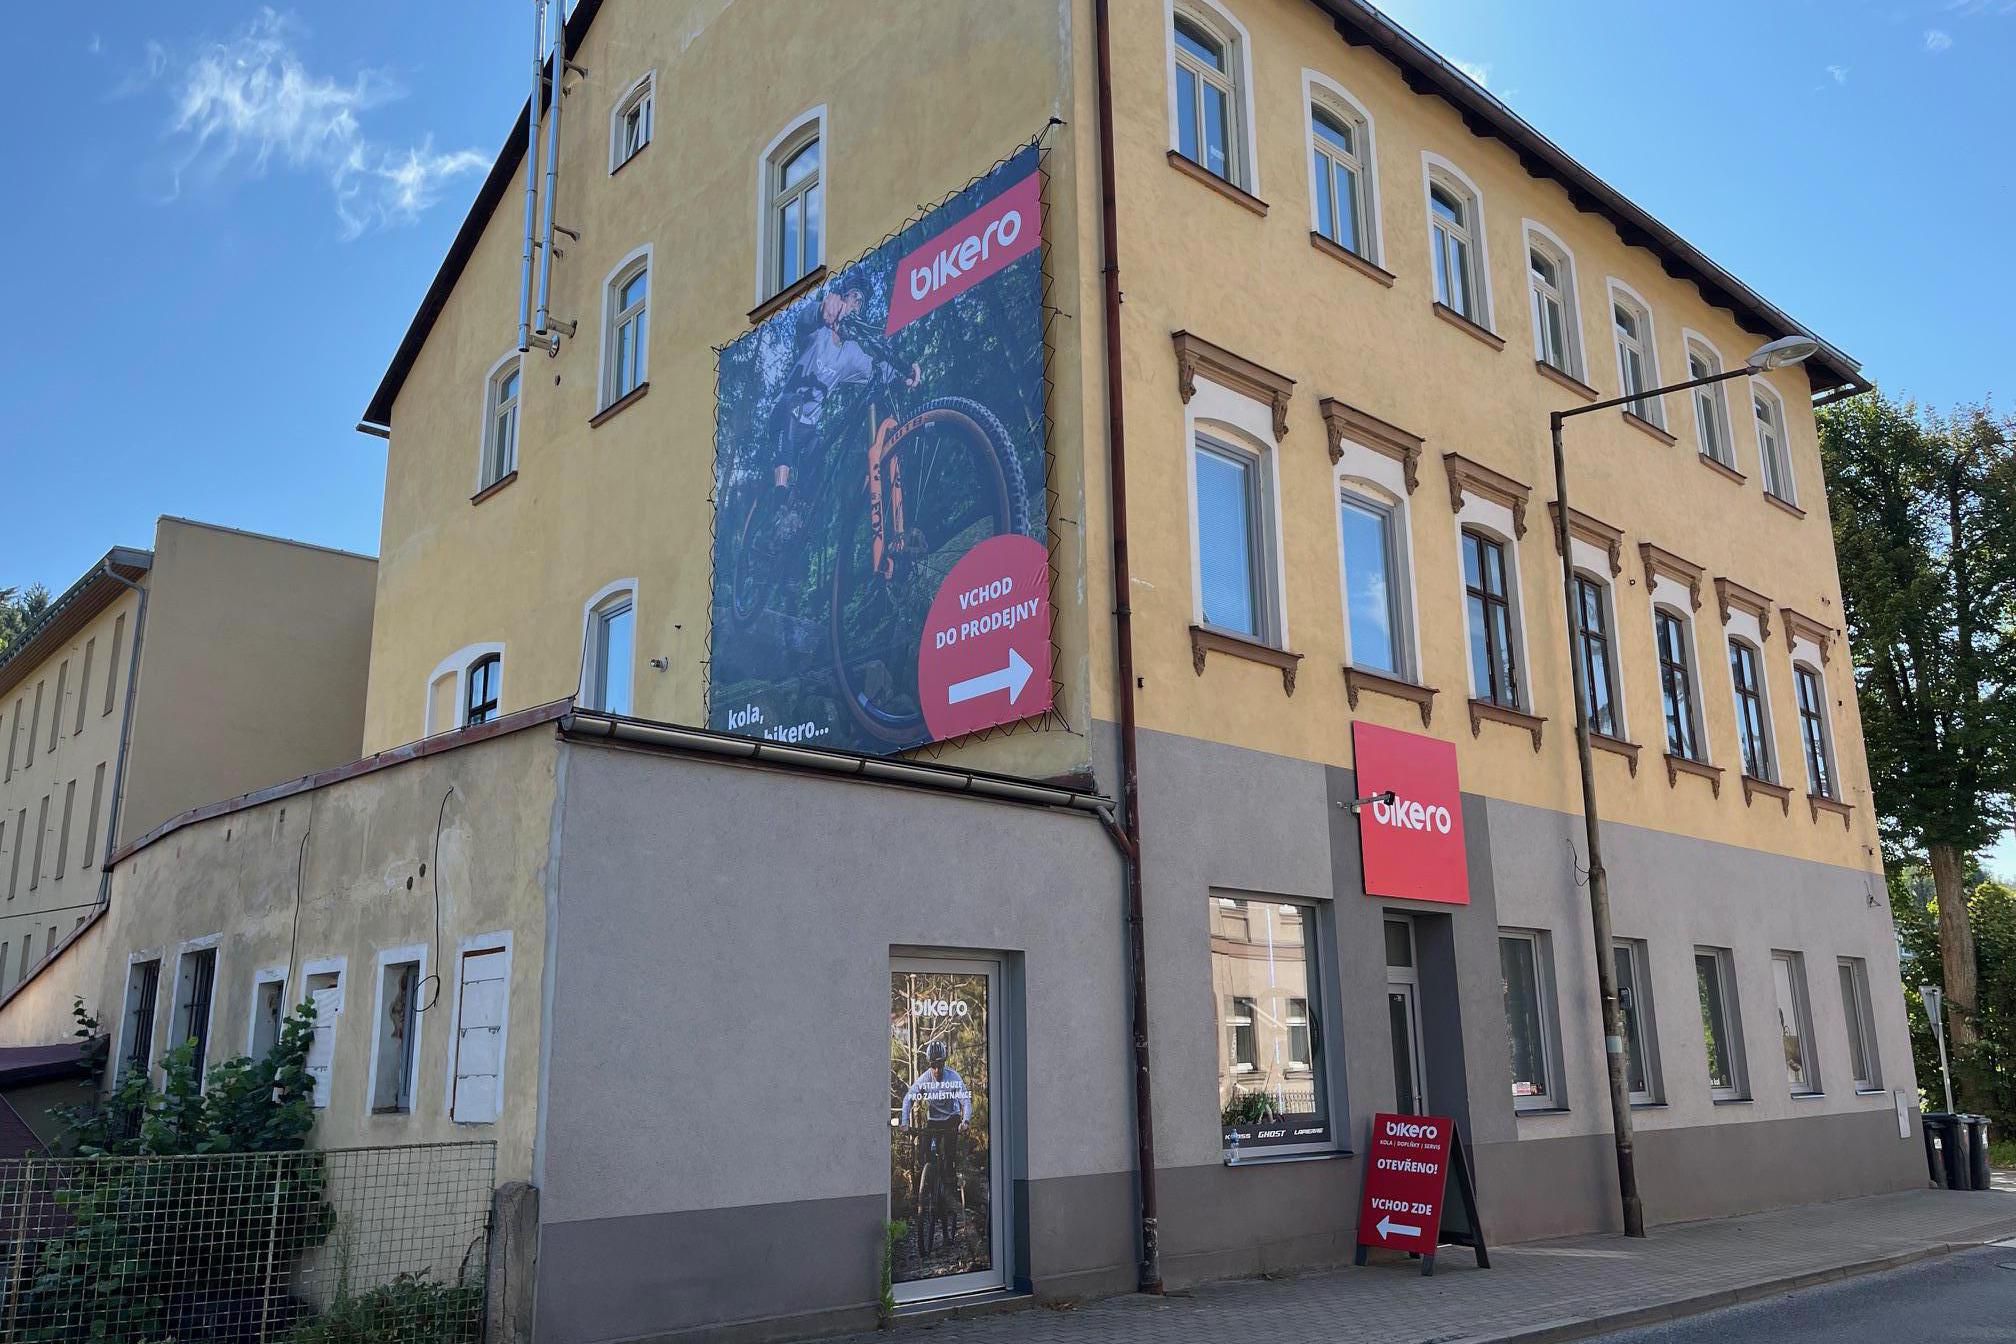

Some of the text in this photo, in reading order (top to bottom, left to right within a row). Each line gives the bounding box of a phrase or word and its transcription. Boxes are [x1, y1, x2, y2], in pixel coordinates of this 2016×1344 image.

[910, 210, 1022, 300] bikero
[959, 576, 1013, 610] VCHOD
[936, 598, 1039, 649] DO PRODEJNY
[728, 704, 764, 730] kola,
[1372, 791, 1451, 834] bikero
[910, 999, 967, 1016] bikero
[918, 1080, 962, 1090] VSTUP POUZE
[908, 1093, 922, 1101] PRO
[1258, 1130, 1286, 1138] GHOST
[1386, 1121, 1438, 1139] bikero
[1377, 1158, 1438, 1174] OTEVŘENO!
[1371, 1198, 1432, 1215] VCHOD ZDE
